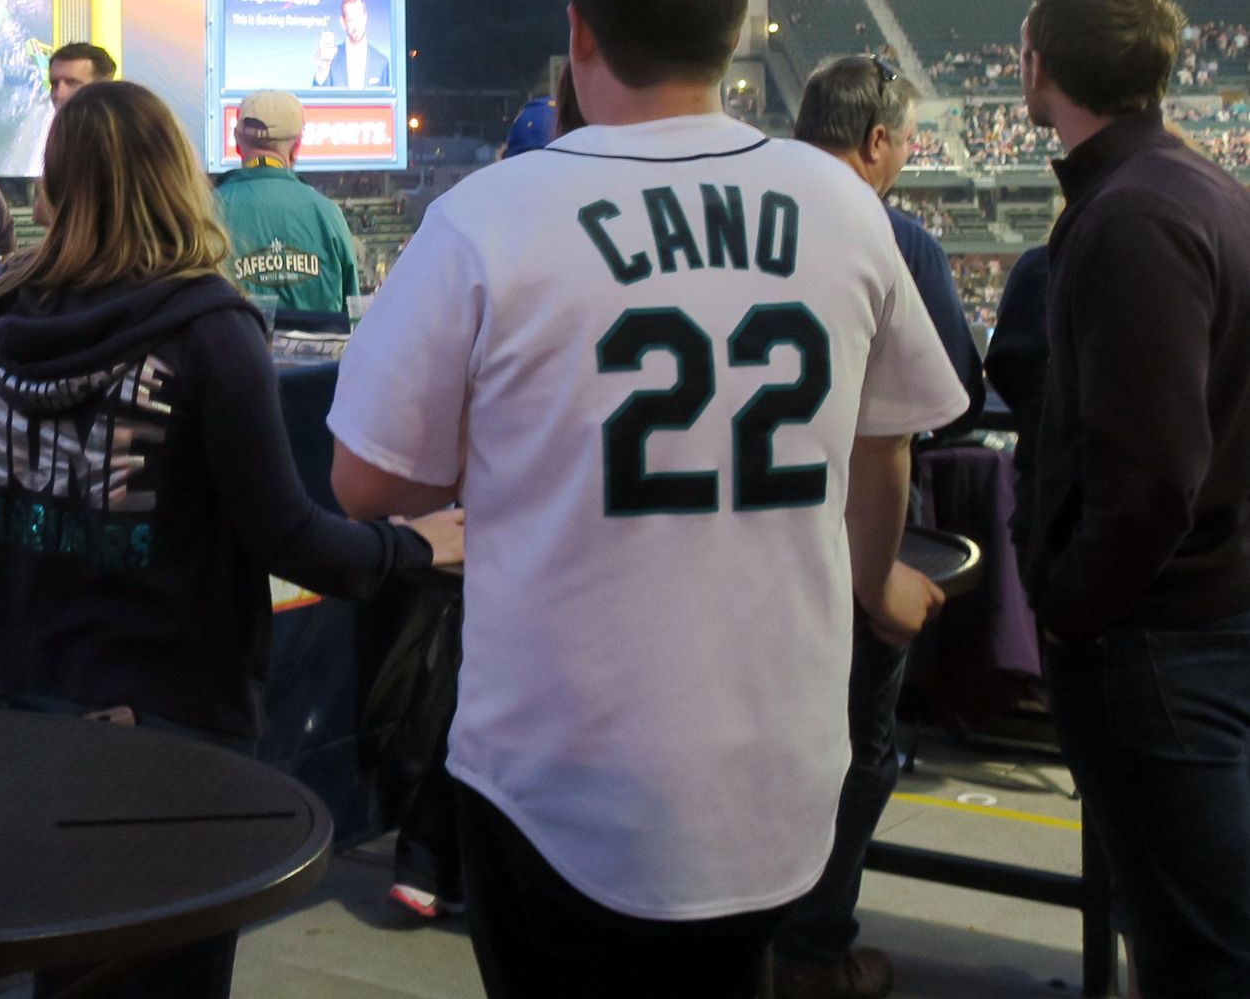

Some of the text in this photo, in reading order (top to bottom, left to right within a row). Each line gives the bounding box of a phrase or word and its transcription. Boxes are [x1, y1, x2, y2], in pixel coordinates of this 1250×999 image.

[234, 254, 319, 280] SAFECO FIELD
[577, 183, 799, 286] CANO
[596, 301, 832, 517] 22
